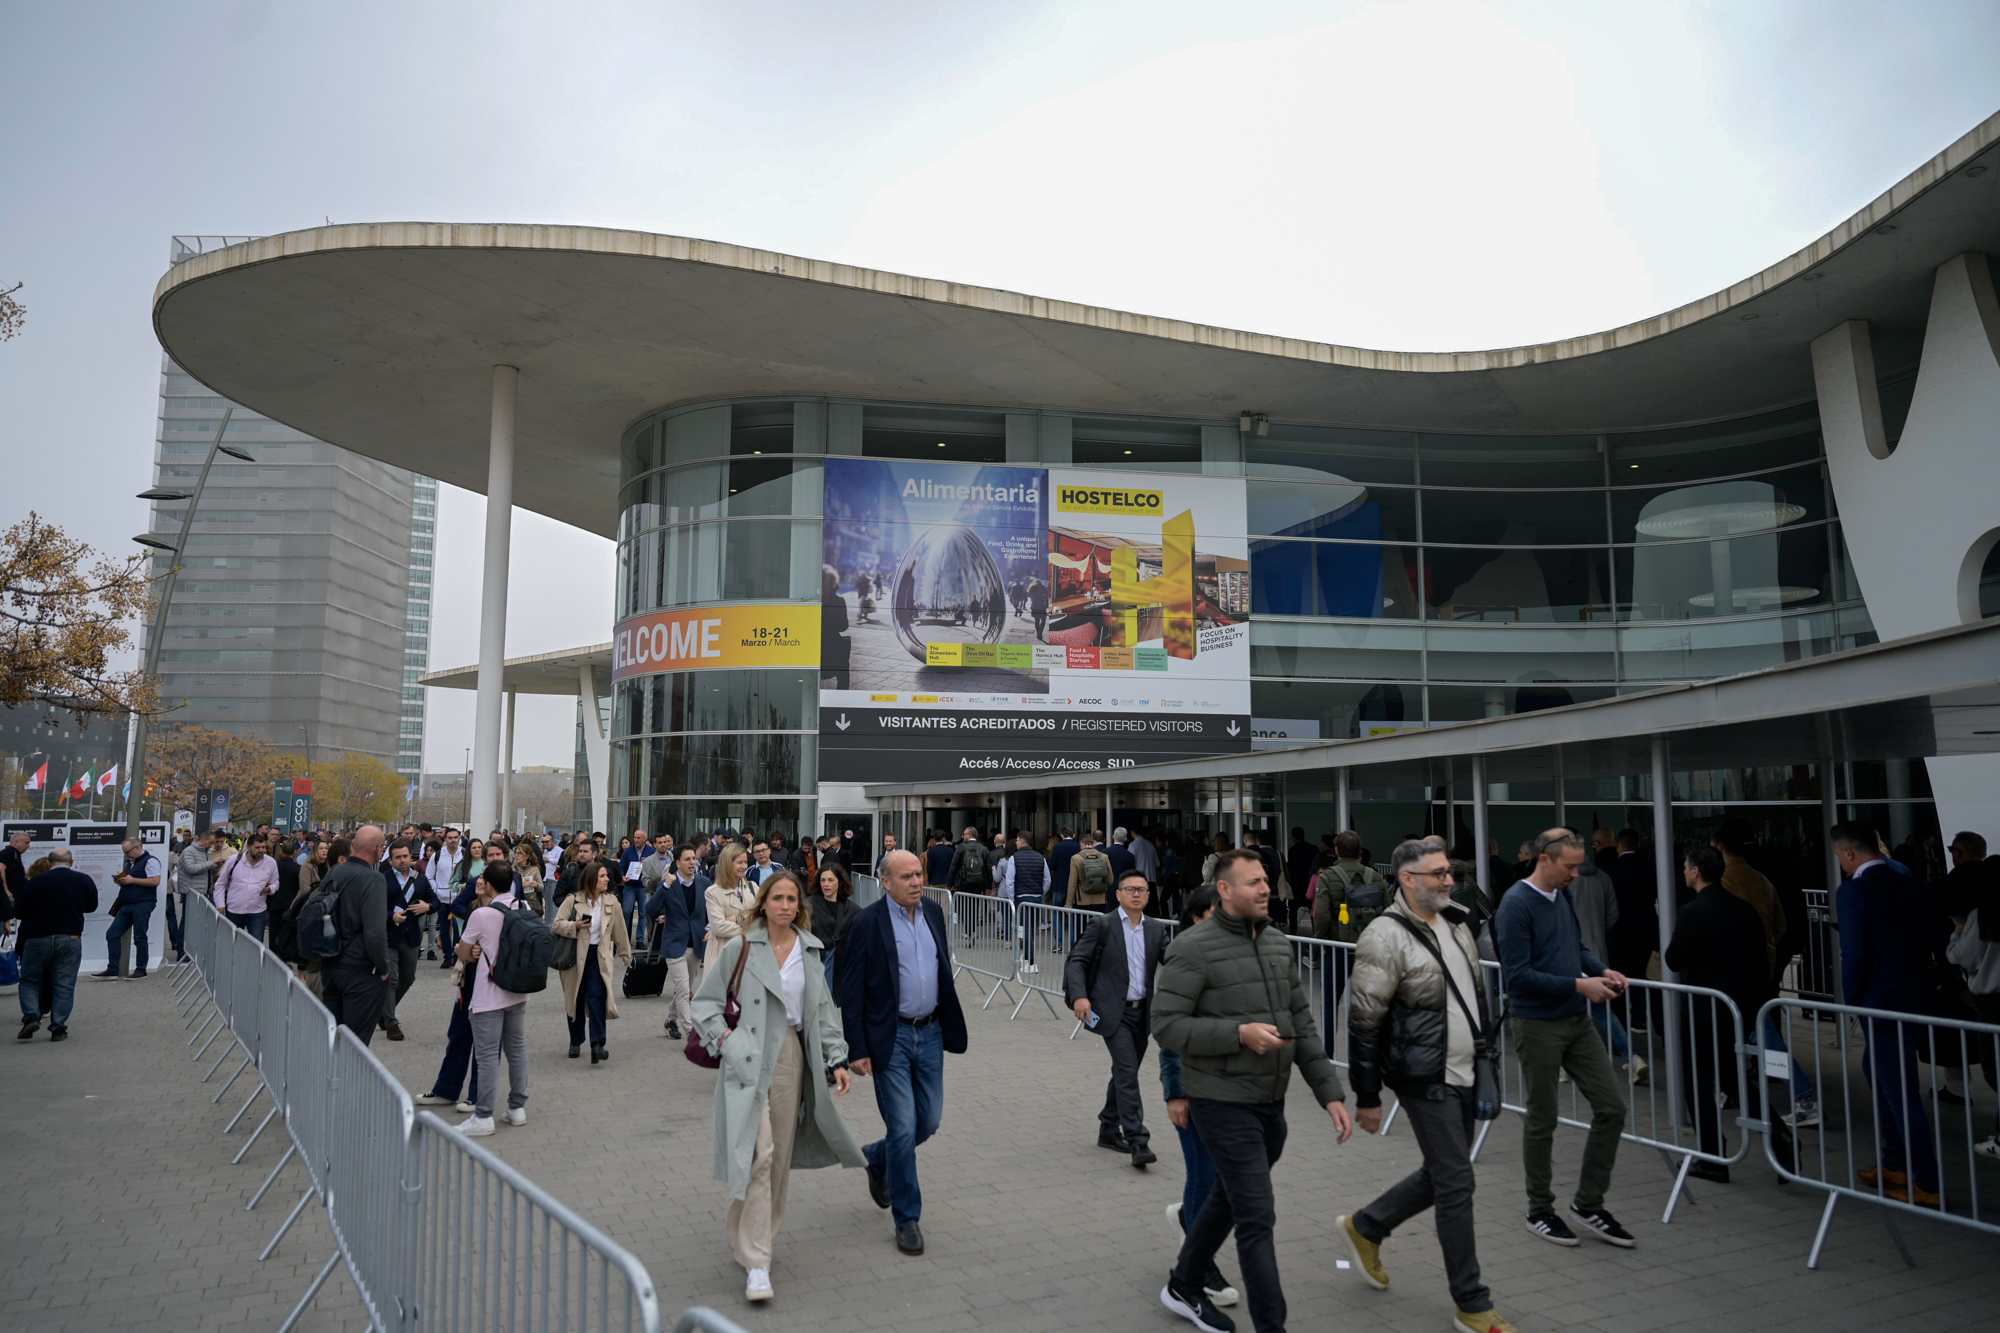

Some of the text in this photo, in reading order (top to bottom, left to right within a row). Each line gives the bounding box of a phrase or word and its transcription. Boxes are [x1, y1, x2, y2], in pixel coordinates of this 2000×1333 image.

[902, 478, 1039, 503] Alimentaria
[1062, 489, 1160, 508] HOSTELCO
[1001, 547, 1037, 555] Gastronomy
[752, 627, 789, 638] 18-21
[1200, 629, 1223, 639] FOCUS
[742, 638, 800, 647] Marzo / March
[1200, 632, 1243, 645] HOSPITALITY
[1200, 641, 1233, 652] BUSINESS
[879, 716, 957, 730] VISITANTES
[960, 717, 1056, 731] ACREDITADOS
[1070, 719, 1147, 732] REGISTERED
[1149, 720, 1204, 733] VISITORS
[1107, 758, 1136, 769] SUD
